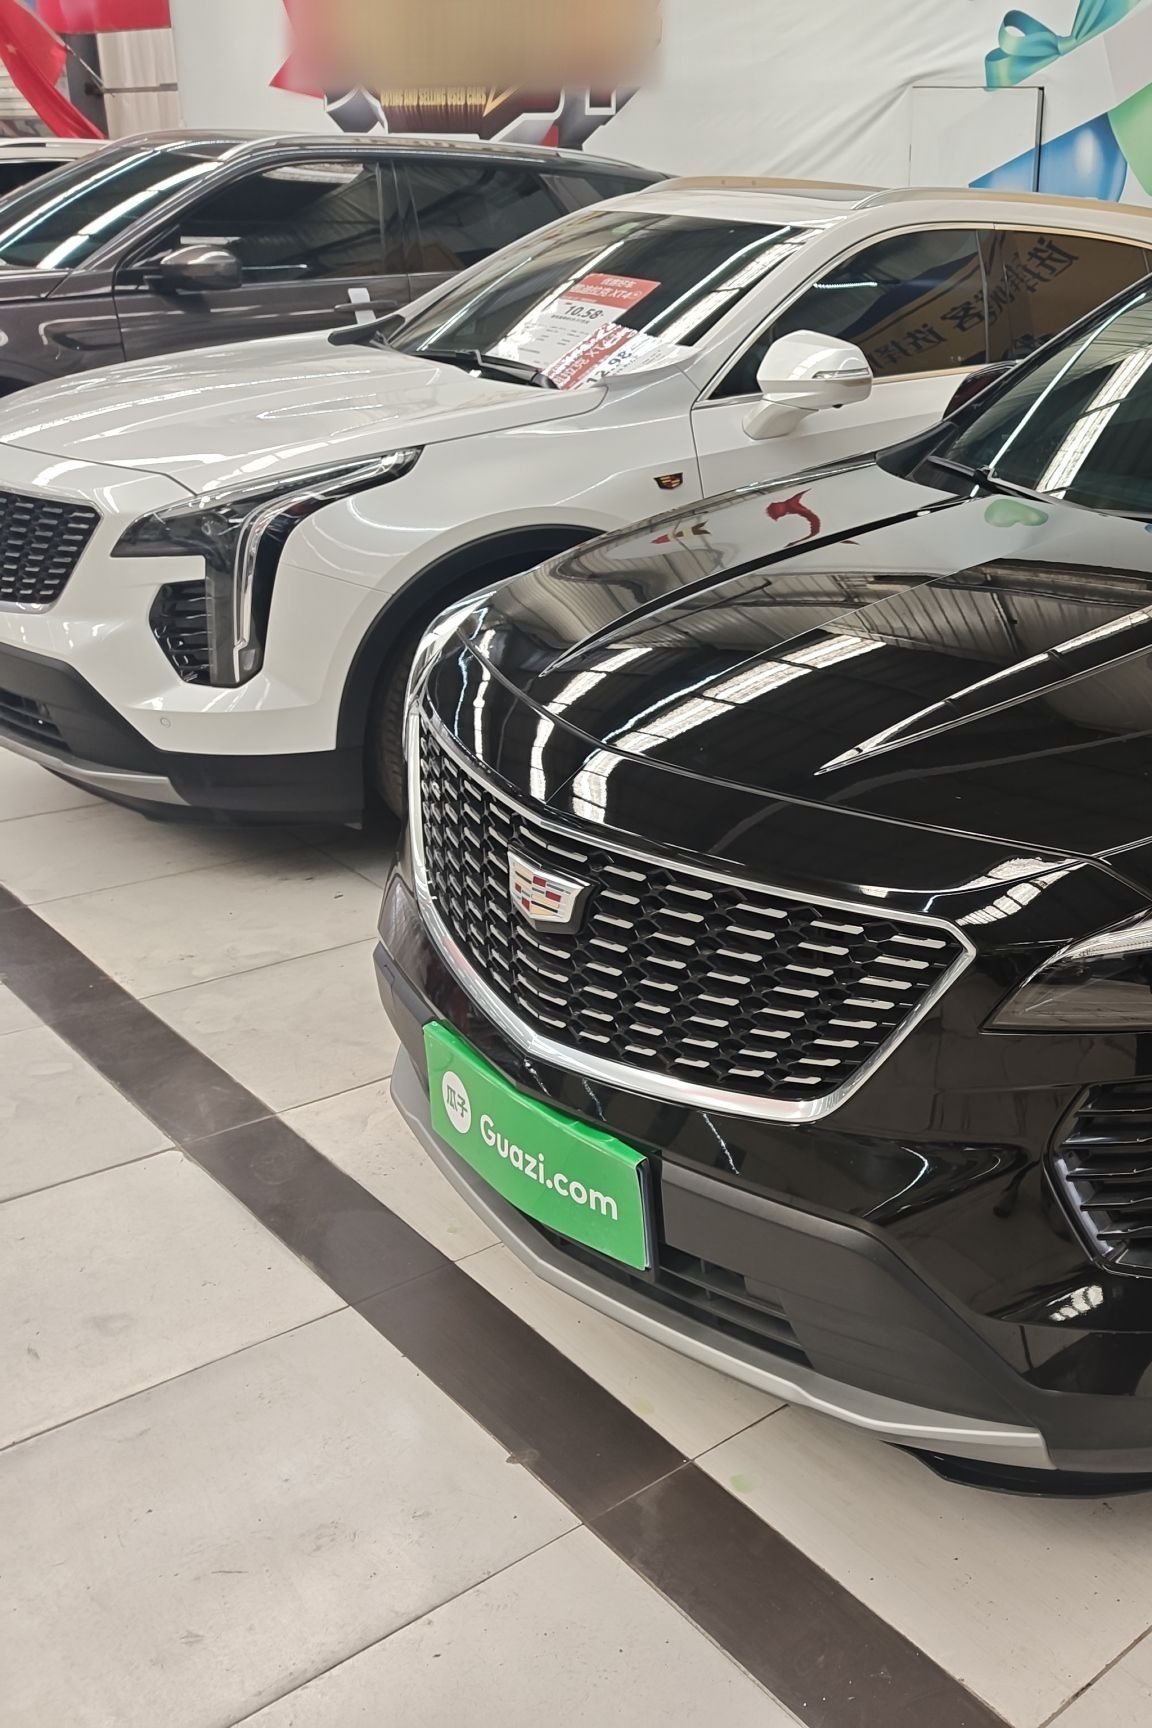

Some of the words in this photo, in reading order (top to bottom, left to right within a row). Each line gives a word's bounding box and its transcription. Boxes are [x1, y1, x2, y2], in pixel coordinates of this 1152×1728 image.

[565, 304, 602, 319] 10.58
[446, 1083, 469, 1119] 瓜子
[479, 1113, 619, 1221] Guazi.com
